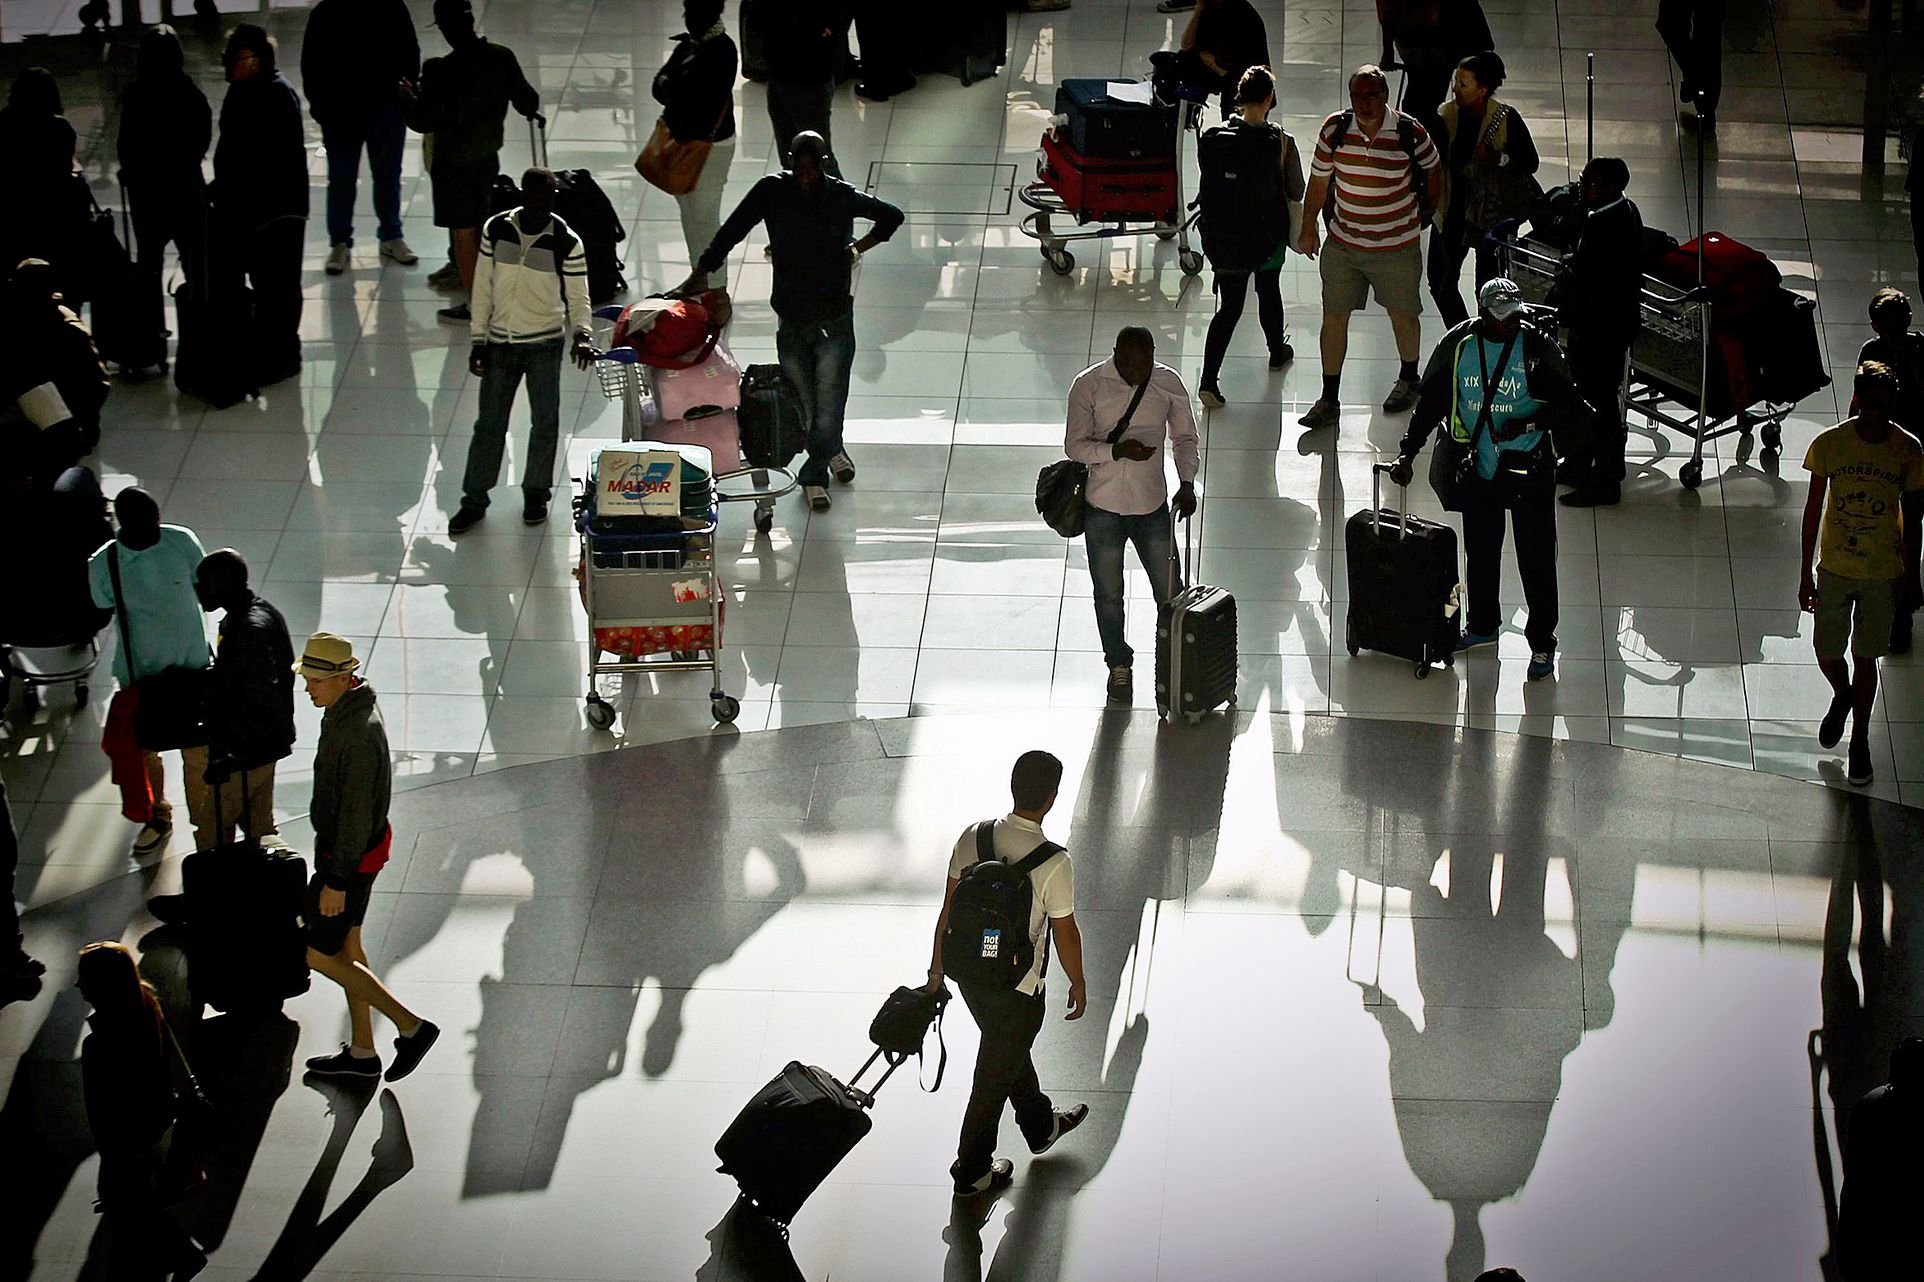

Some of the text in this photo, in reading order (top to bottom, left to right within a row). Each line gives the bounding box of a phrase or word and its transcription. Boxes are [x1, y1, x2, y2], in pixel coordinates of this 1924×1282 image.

[1464, 376, 1480, 387] XIX
[607, 480, 672, 493] MADAR
[984, 935, 999, 944] not
[982, 950, 998, 958] BAG!
